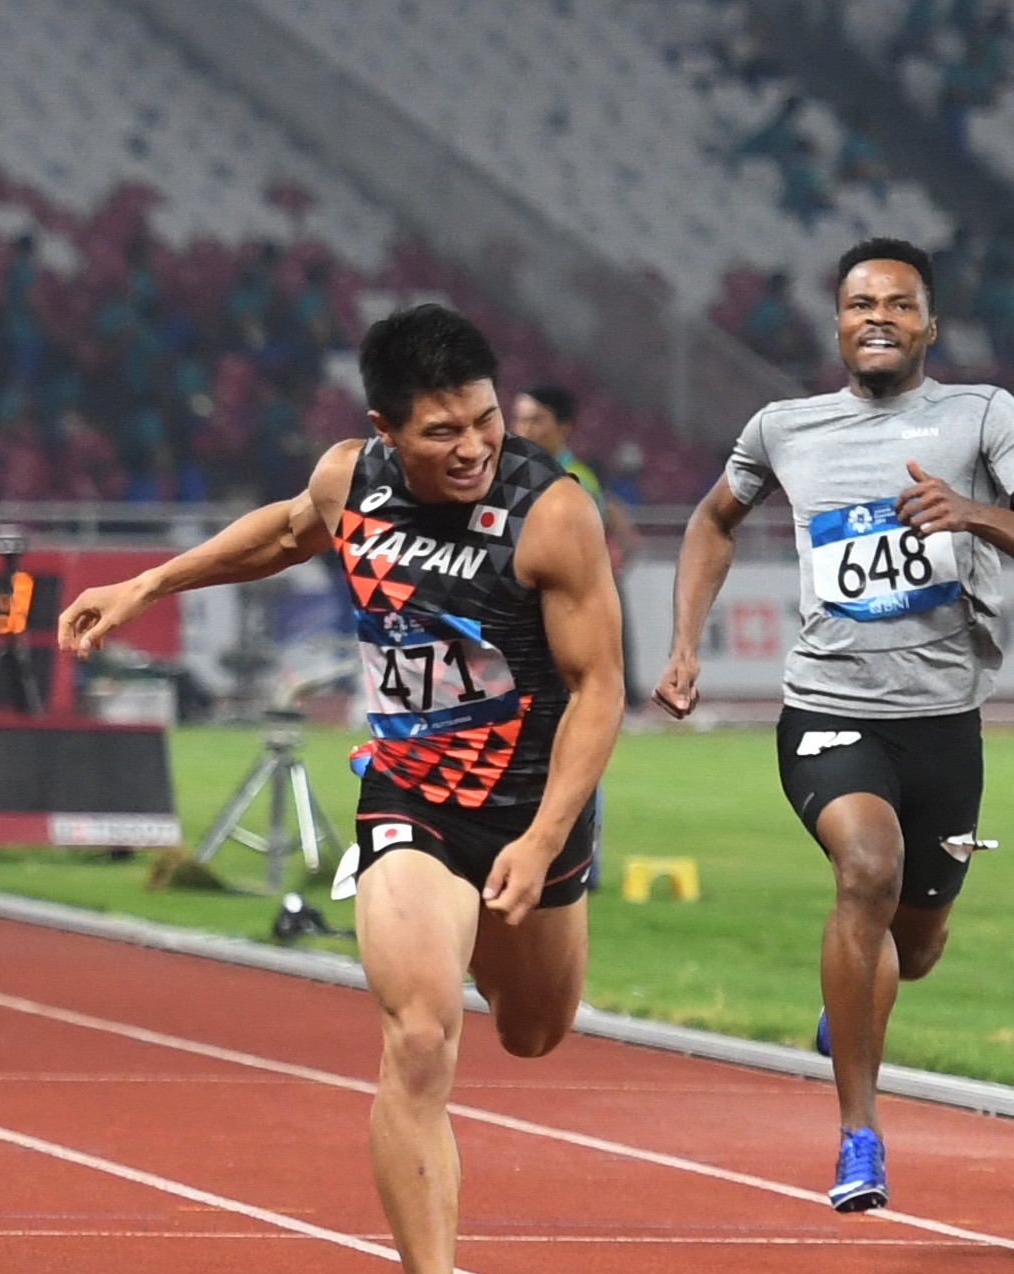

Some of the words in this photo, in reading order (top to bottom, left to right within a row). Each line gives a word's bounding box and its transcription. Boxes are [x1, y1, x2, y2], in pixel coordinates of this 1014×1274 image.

[901, 427, 939, 440] OMAN
[349, 527, 487, 580] JAPAN
[837, 529, 934, 599] 648
[379, 639, 486, 711] 471
